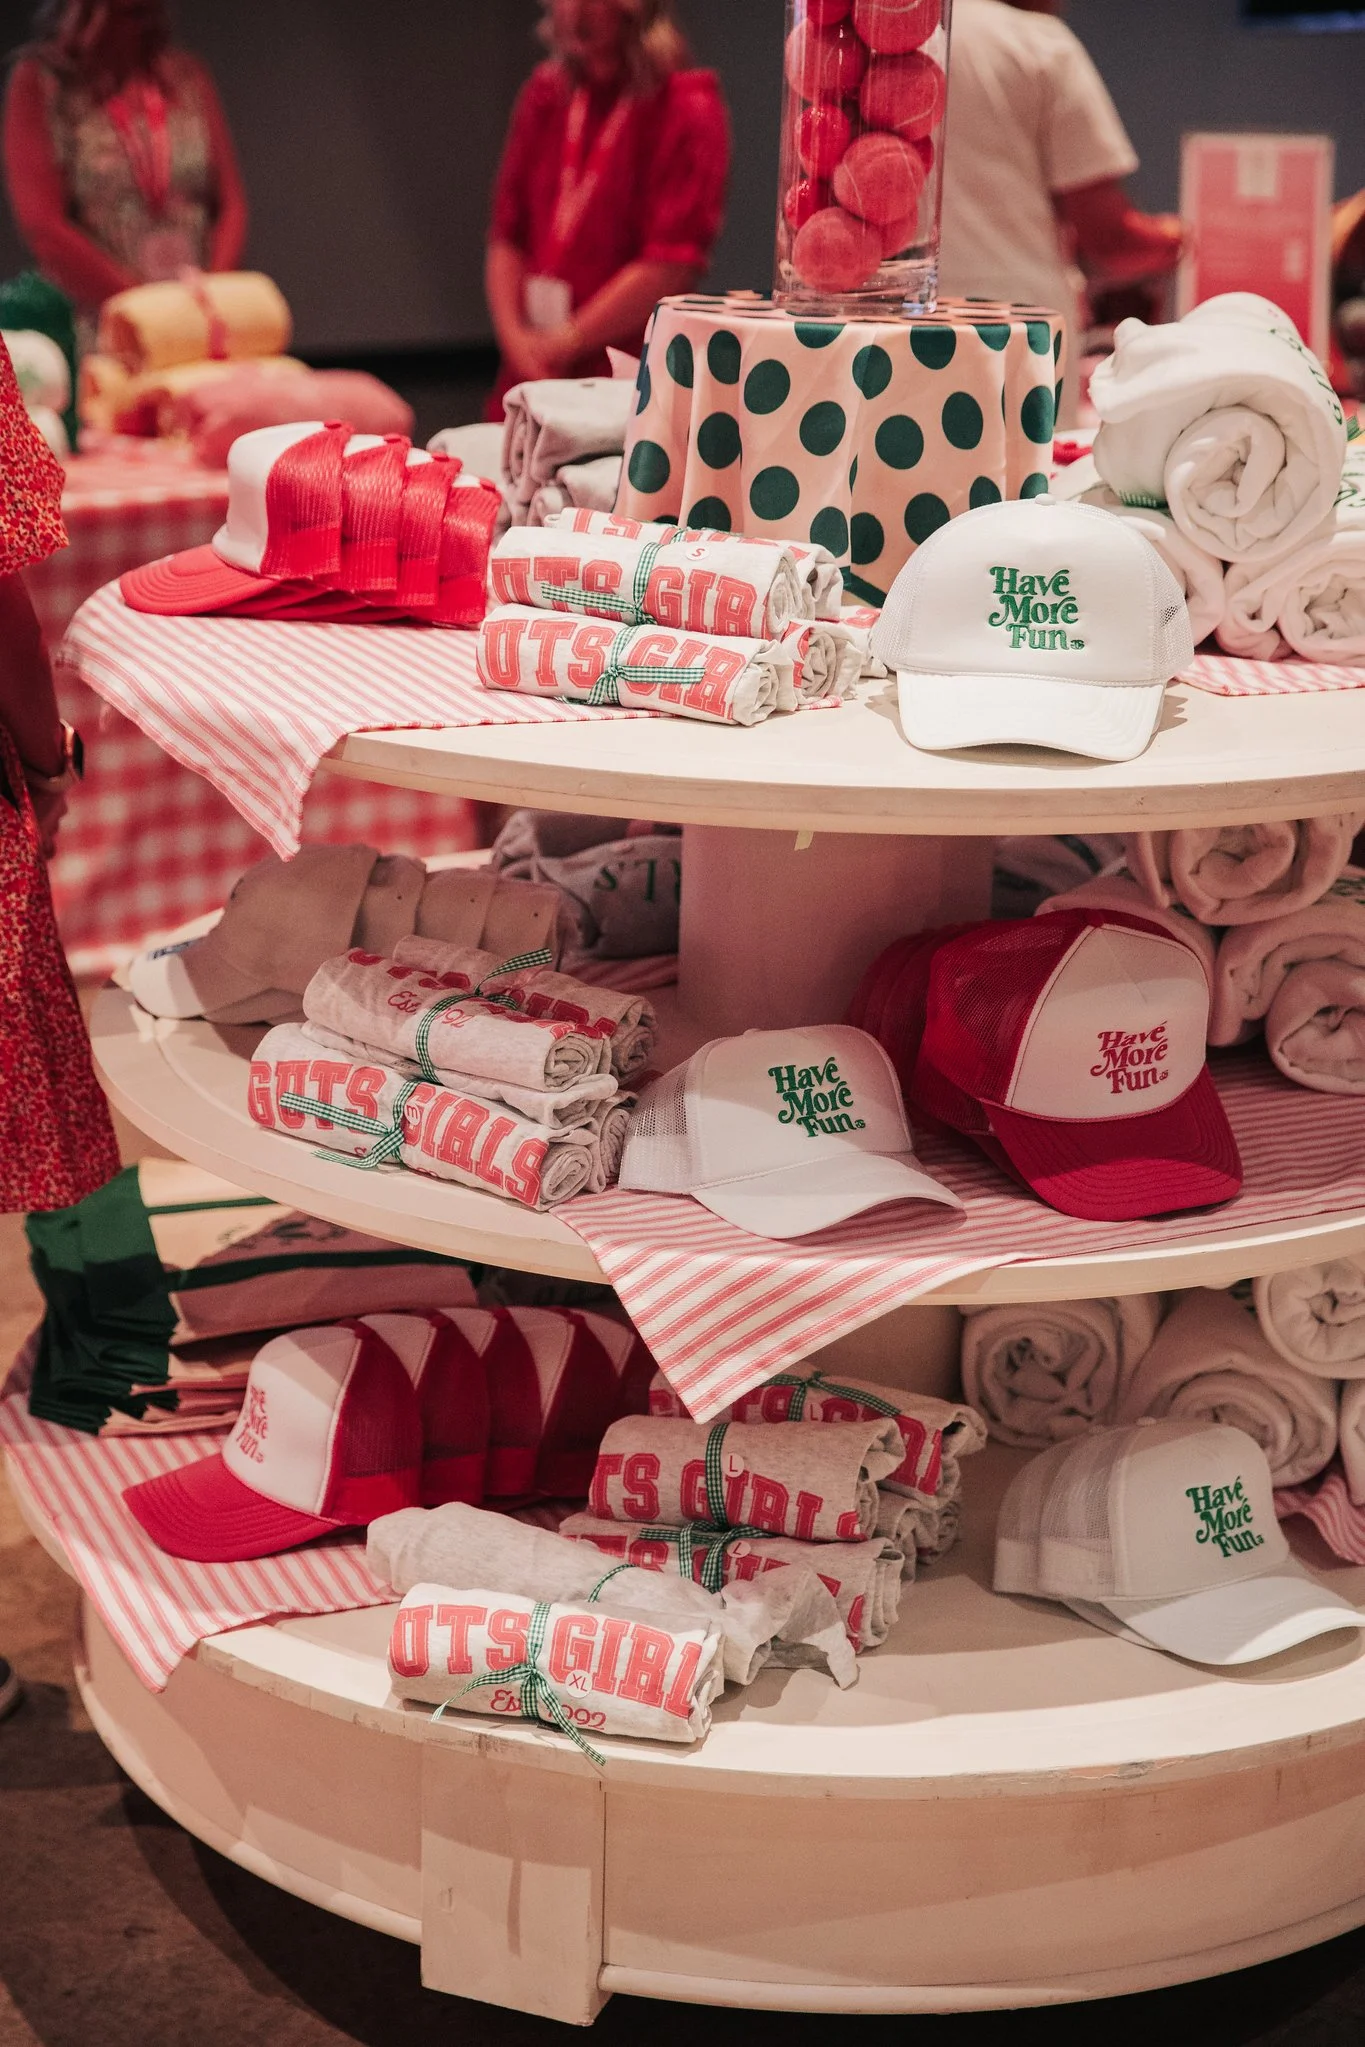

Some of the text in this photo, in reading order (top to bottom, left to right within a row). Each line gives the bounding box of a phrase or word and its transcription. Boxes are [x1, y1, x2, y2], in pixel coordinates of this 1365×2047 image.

[691, 548, 705, 557] S
[989, 566, 1070, 596] Have
[643, 565, 773, 641] GIR
[988, 594, 1079, 627] More
[1006, 623, 1070, 650] Fun
[476, 619, 746, 720] UTS GIR
[1097, 1021, 1168, 1052] Have
[1090, 1038, 1168, 1076] More
[768, 1057, 840, 1093] Have
[1105, 1067, 1160, 1094] Fun
[778, 1081, 854, 1124] More
[248, 1060, 549, 1206] GUTS GIRLS
[796, 1113, 857, 1137] Fun
[729, 1455, 738, 1472] L
[1185, 1476, 1243, 1513] Have
[1196, 1498, 1253, 1543] More
[733, 1542, 742, 1555] L
[1212, 1530, 1259, 1557] Fun
[569, 1674, 588, 1692] XL
[490, 1690, 521, 1712] Es
